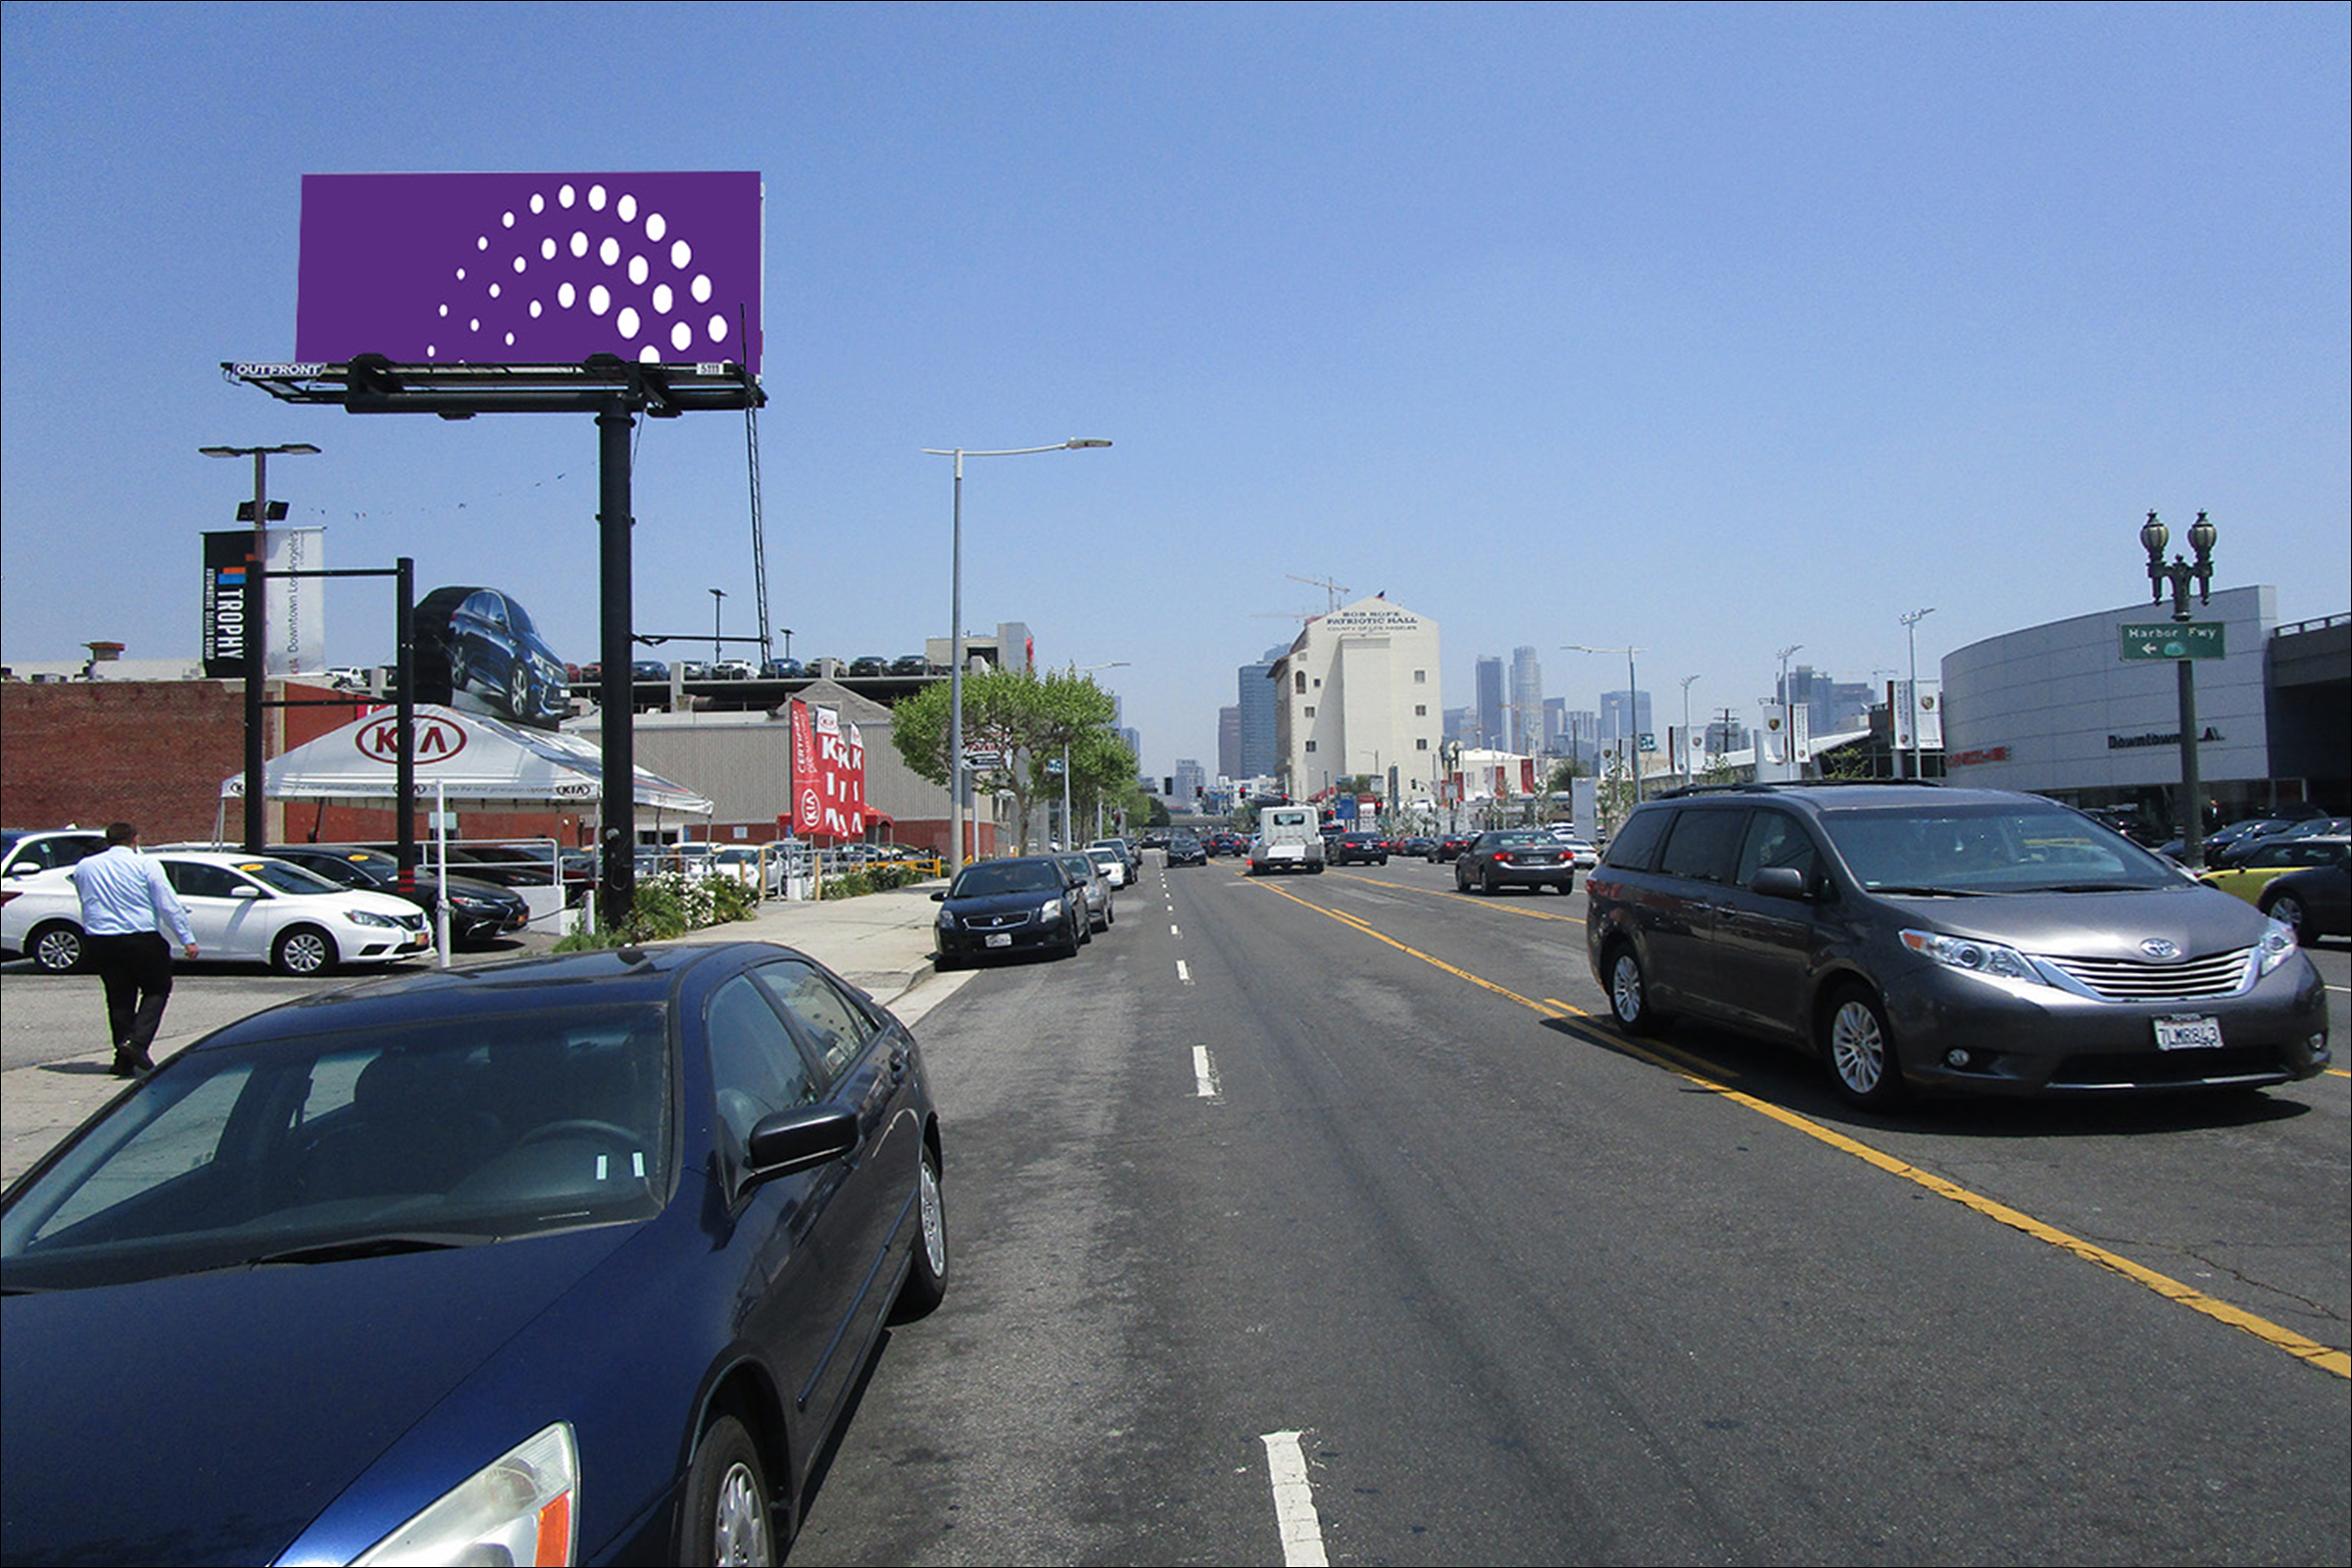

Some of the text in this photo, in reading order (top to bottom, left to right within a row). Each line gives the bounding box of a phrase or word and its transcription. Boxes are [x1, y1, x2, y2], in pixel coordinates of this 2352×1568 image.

[236, 364, 320, 375] OUTFRONT
[287, 529, 301, 571] Angeles
[217, 588, 244, 660] TROPHY
[287, 595, 299, 654] Downtown
[2129, 627, 2217, 640] Harbor Fwy
[374, 726, 448, 754] KA
[2108, 732, 2181, 750] Downtown
[563, 785, 585, 795] KIA
[821, 735, 840, 833] KIA
[851, 747, 863, 833] KIA
[806, 795, 817, 821] KIA
